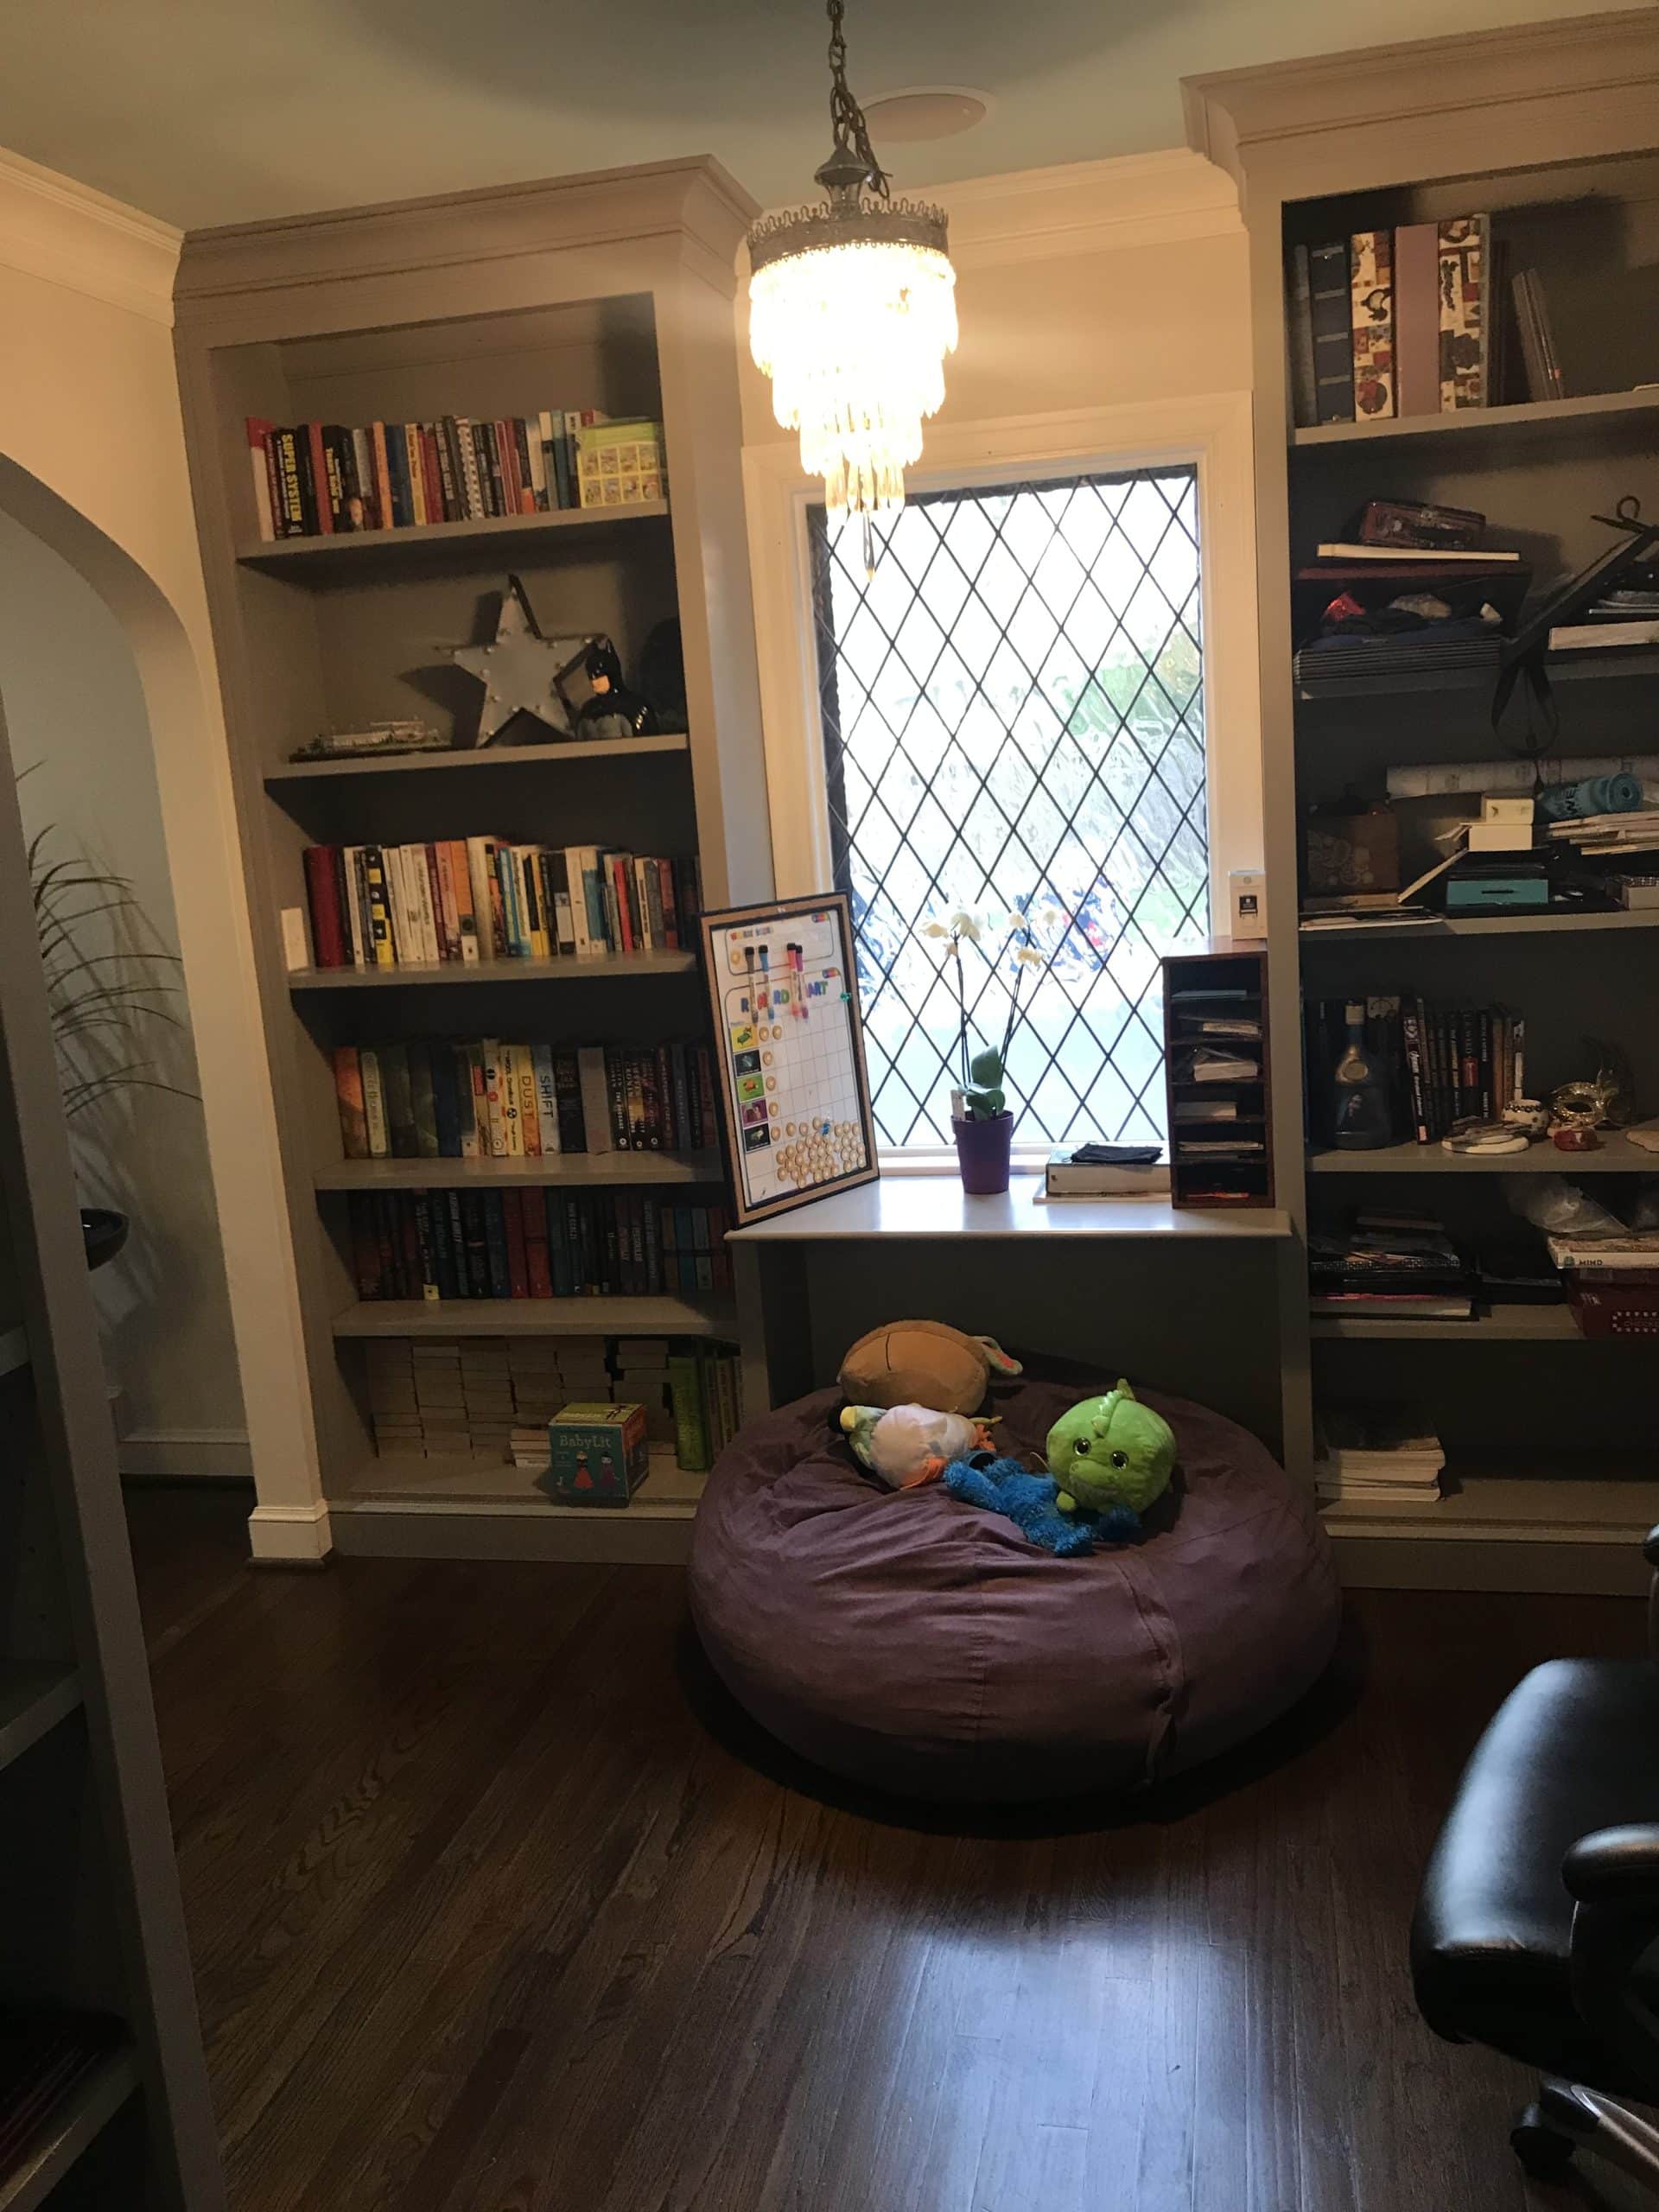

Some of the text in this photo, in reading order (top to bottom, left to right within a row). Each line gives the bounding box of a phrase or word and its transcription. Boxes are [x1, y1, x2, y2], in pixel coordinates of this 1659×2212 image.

[282, 434, 302, 521] SUPER SYSTEM
[739, 986, 791, 1013] RWRD
[521, 1075, 534, 1120] DUST
[539, 1075, 553, 1118] SHIFT
[560, 1433, 612, 1449] BabyLit
